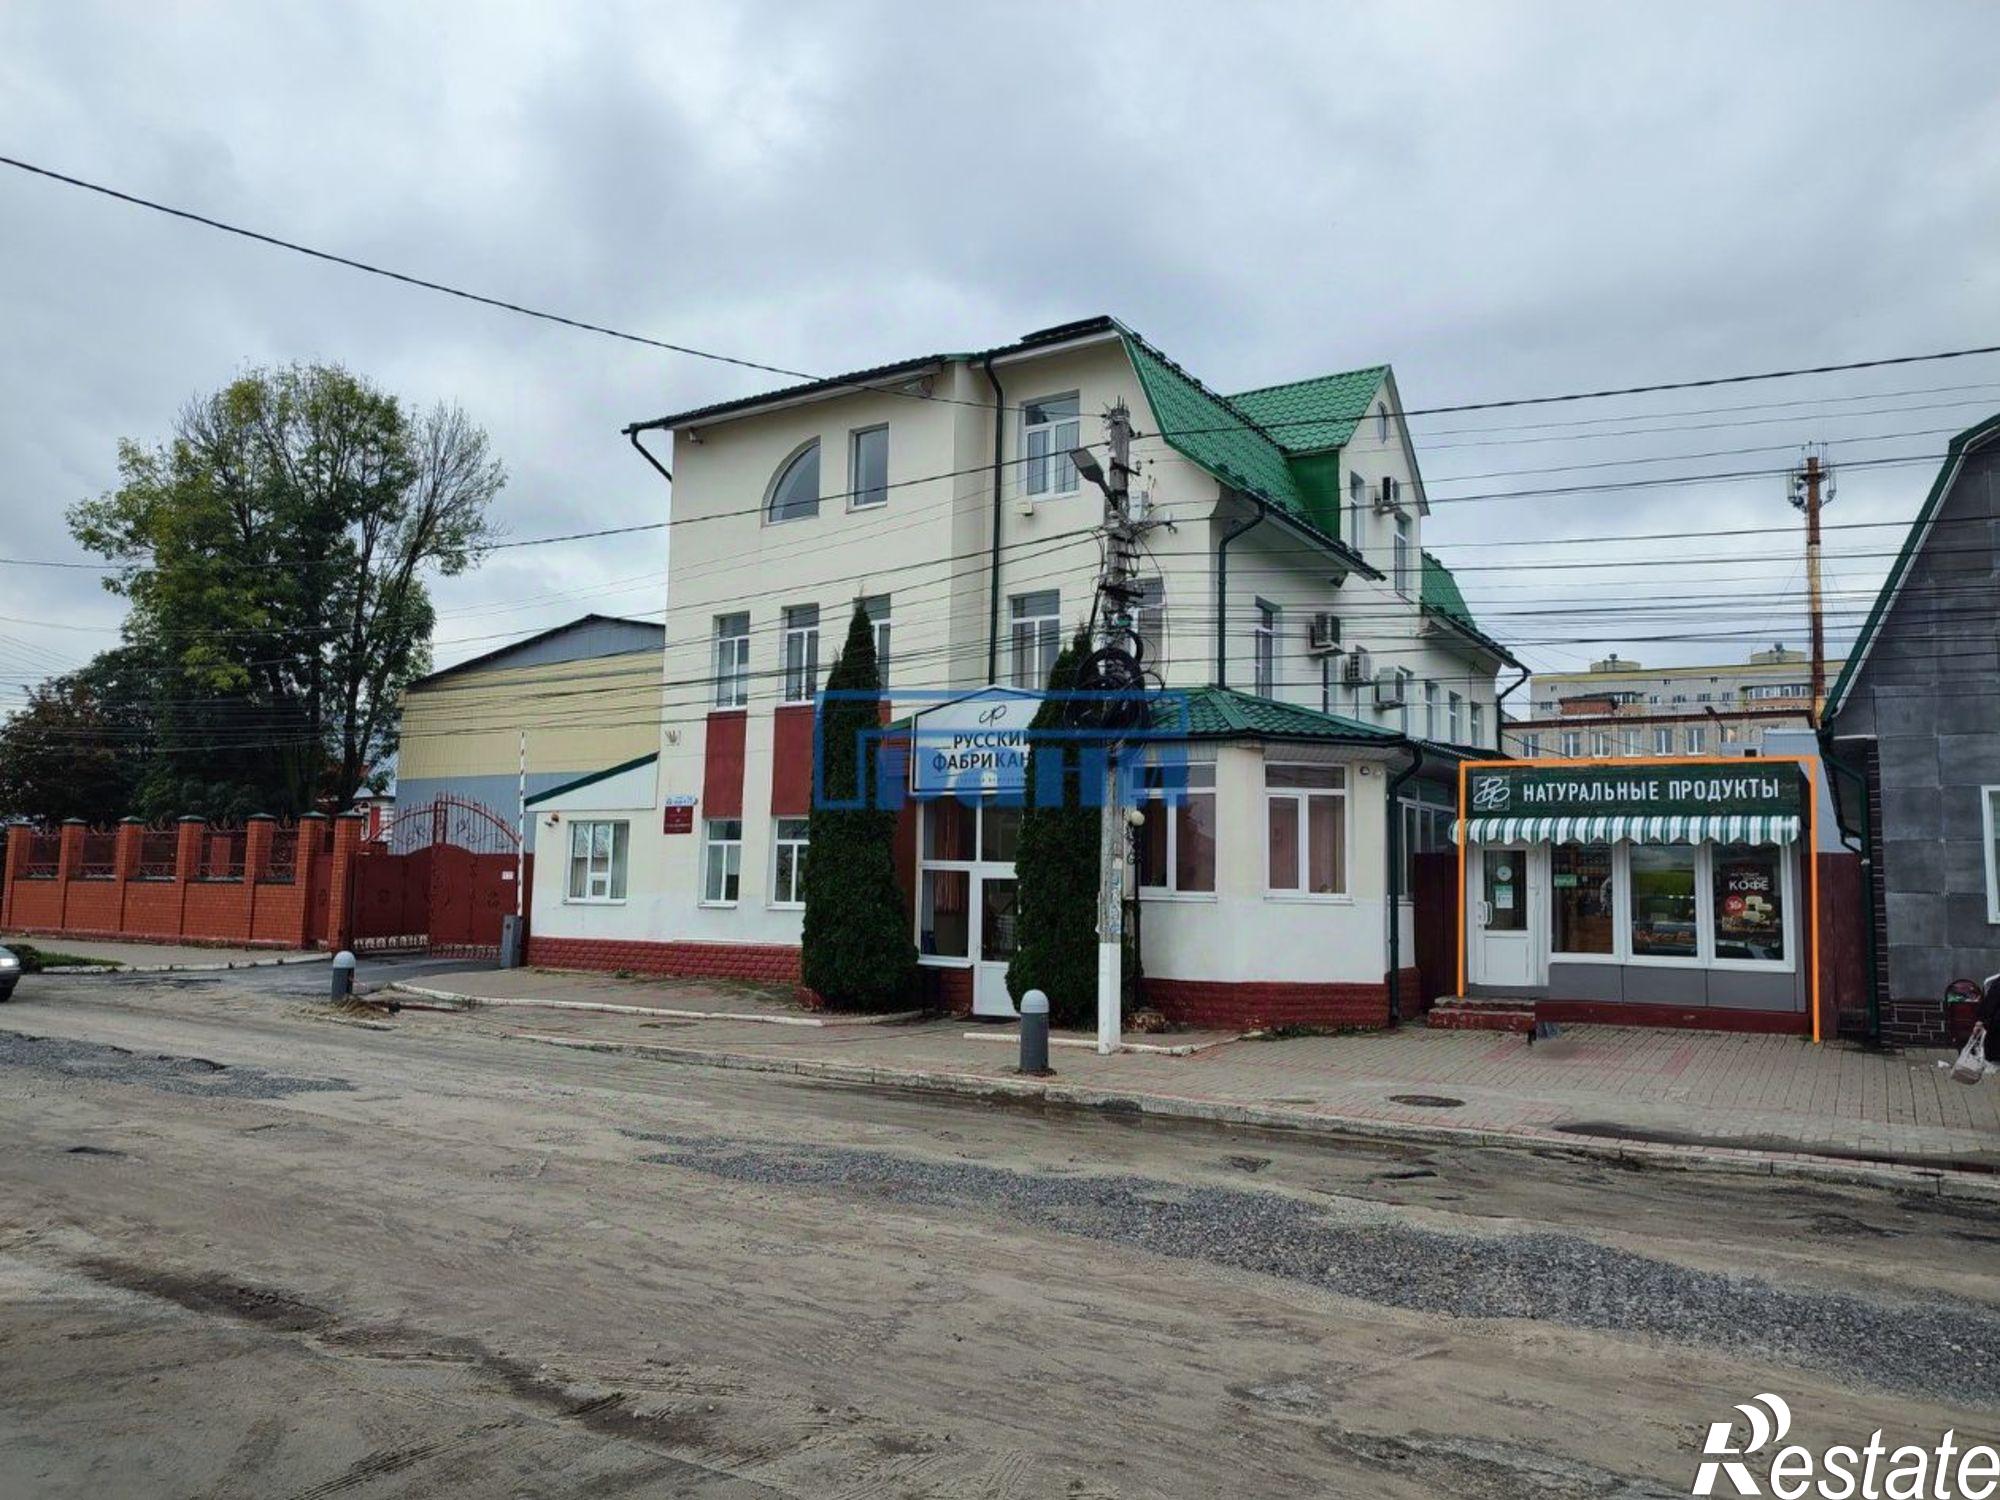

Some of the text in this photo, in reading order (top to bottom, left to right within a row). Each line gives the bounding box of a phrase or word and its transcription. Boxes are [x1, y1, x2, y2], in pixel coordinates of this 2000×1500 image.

[932, 752, 1033, 773] ФАБРИКАН
[1522, 781, 1659, 802] НАТУРАЛЬНЫЕ
[1669, 778, 1779, 802] ПРОДУКТЫ
[1729, 880, 1769, 890] КОФЕ
